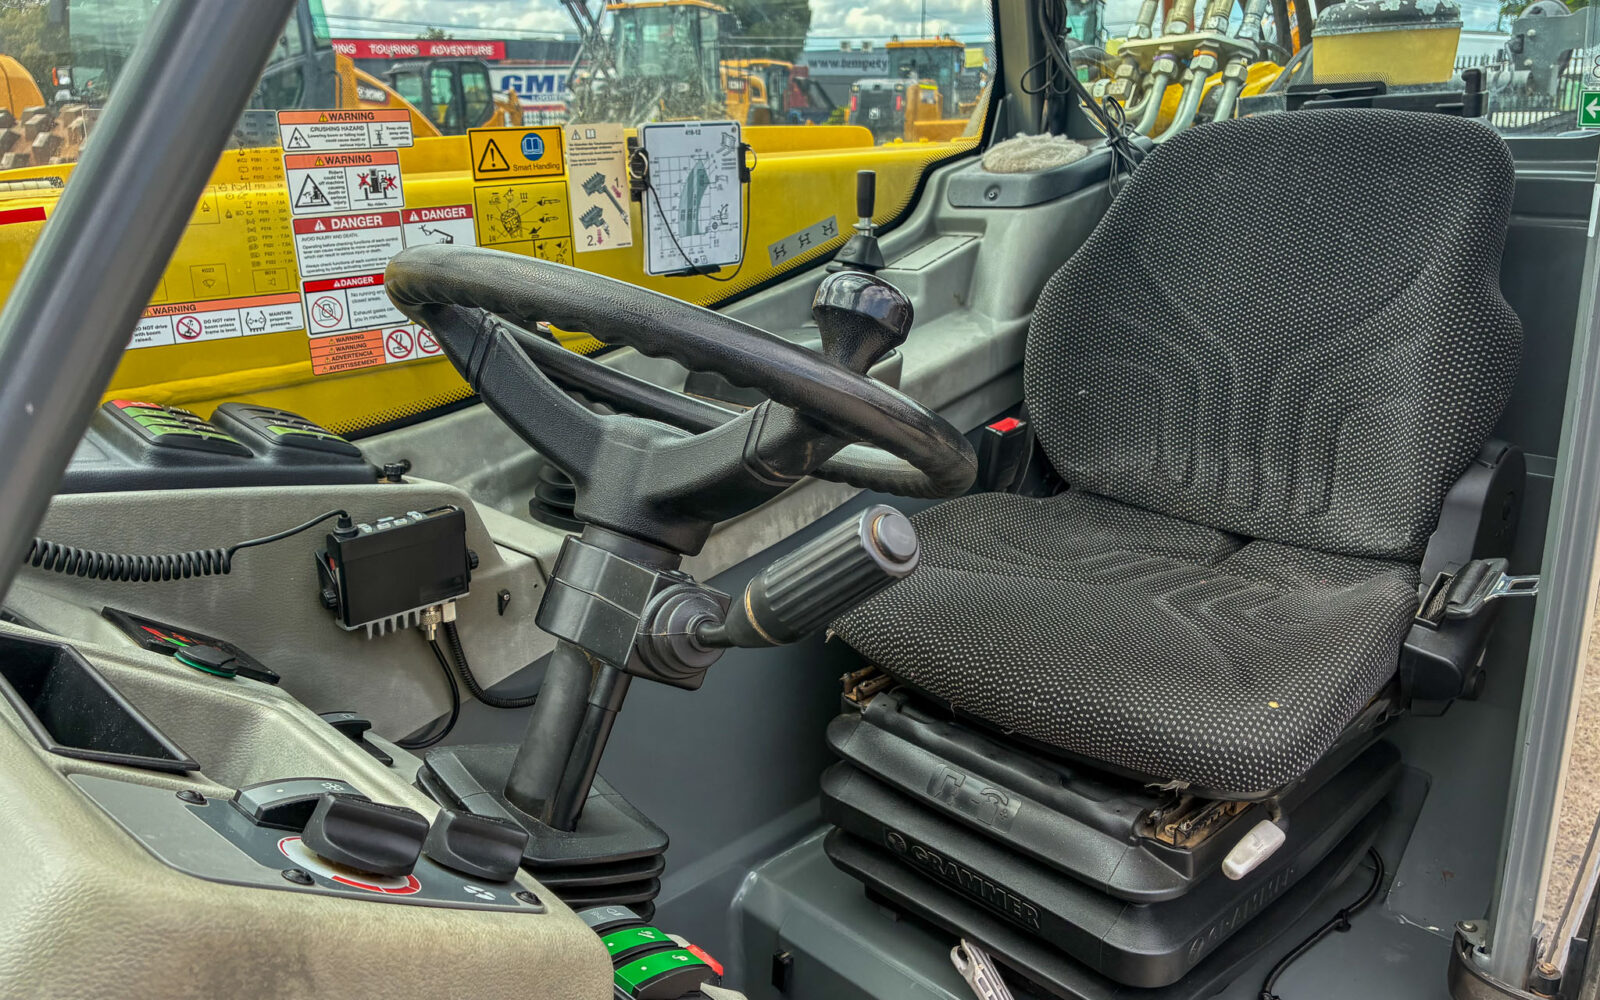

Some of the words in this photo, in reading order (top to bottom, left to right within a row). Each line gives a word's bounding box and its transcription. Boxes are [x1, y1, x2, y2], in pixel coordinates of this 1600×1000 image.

[368, 44, 419, 56] TOURING
[430, 45, 494, 56] ADVENTURE
[328, 112, 374, 120] WARNING
[325, 155, 372, 165] WARNING
[512, 163, 532, 171] Smart
[533, 161, 560, 171] Handling
[614, 176, 623, 188] 1.
[421, 208, 467, 220] DANGER
[331, 216, 383, 230] DANGER
[587, 235, 597, 246] 2.
[340, 276, 374, 286] DANGER
[152, 304, 196, 315] WARNING
[335, 343, 367, 351] WARNUNG
[332, 351, 373, 361] ADVERTENCIA
[328, 358, 378, 371] AVERTISSEMENT
[911, 845, 1040, 930] GRAMMER
